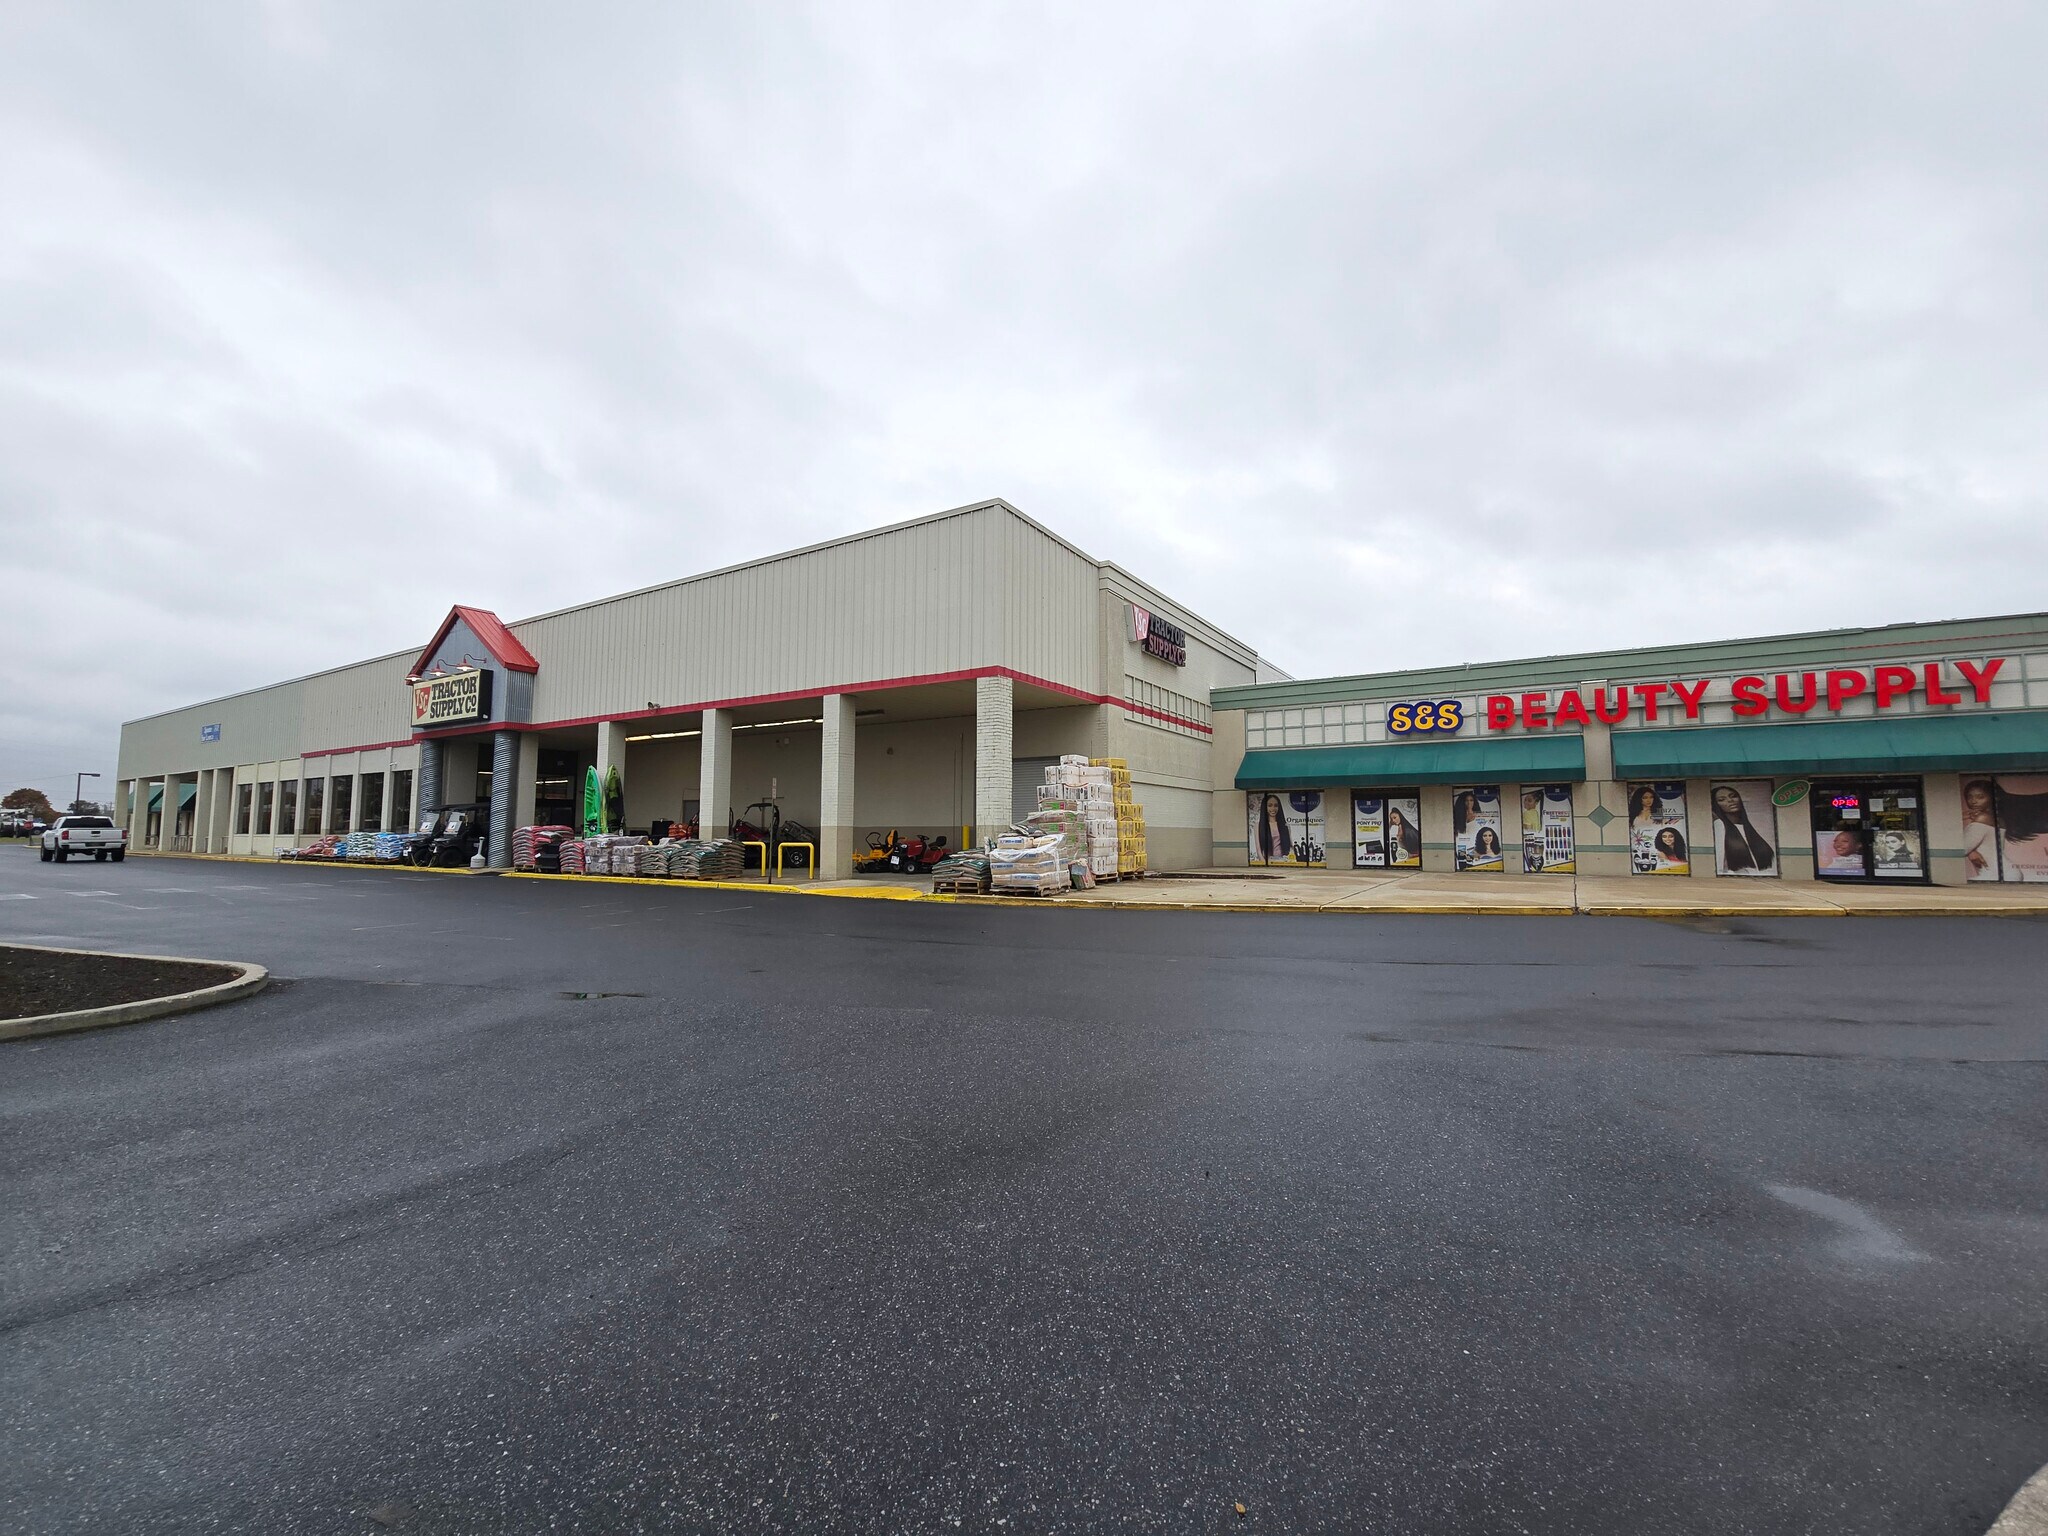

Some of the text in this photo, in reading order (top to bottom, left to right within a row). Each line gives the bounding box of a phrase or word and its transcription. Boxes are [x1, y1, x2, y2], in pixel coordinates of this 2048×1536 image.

[1149, 613, 1186, 648] TRACTOR
[1148, 634, 1178, 661] SUPPLY
[415, 689, 429, 712] TSC
[431, 676, 478, 701] TRACTOR
[1389, 658, 2006, 732] S&S BEAUTY SUPPLY
[429, 698, 465, 719] SUPPLY
[1778, 784, 1805, 802] OPEN
[1831, 798, 1859, 807] OPEN
